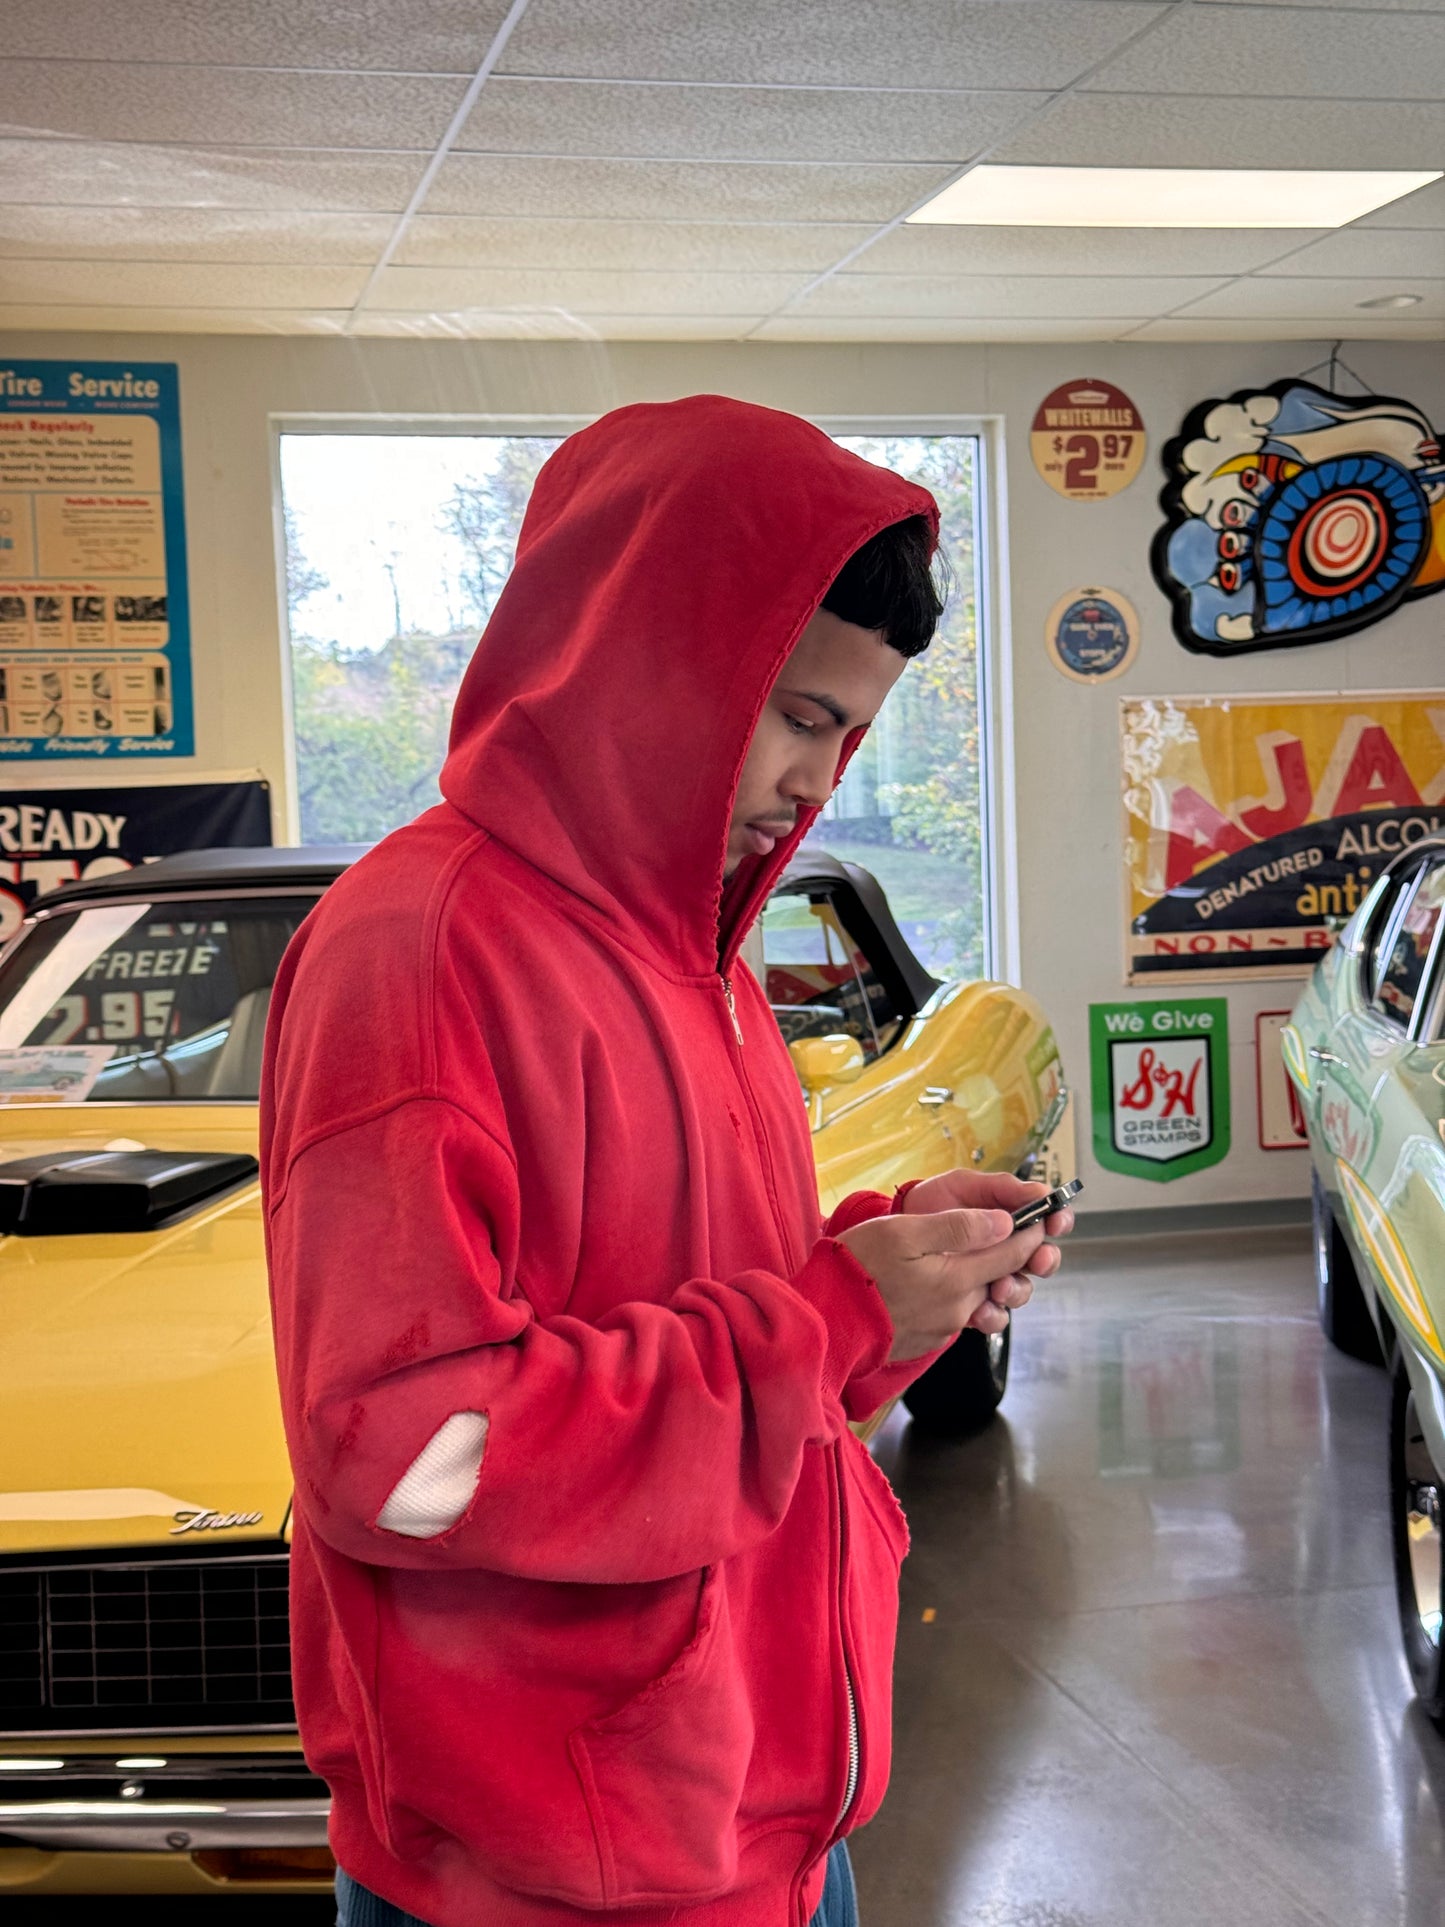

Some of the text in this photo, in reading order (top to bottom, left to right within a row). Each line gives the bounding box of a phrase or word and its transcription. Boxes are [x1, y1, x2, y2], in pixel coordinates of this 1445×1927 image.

[69, 372, 160, 398] Service
[30, 420, 94, 434] Regularly
[1045, 408, 1133, 427] WHITEWALLS
[1195, 817, 1440, 919] DENATURED ALCO
[1104, 1010, 1213, 1033] We Give
[1123, 1117, 1201, 1133] GREEN
[1124, 1129, 1201, 1146] STAMPS
